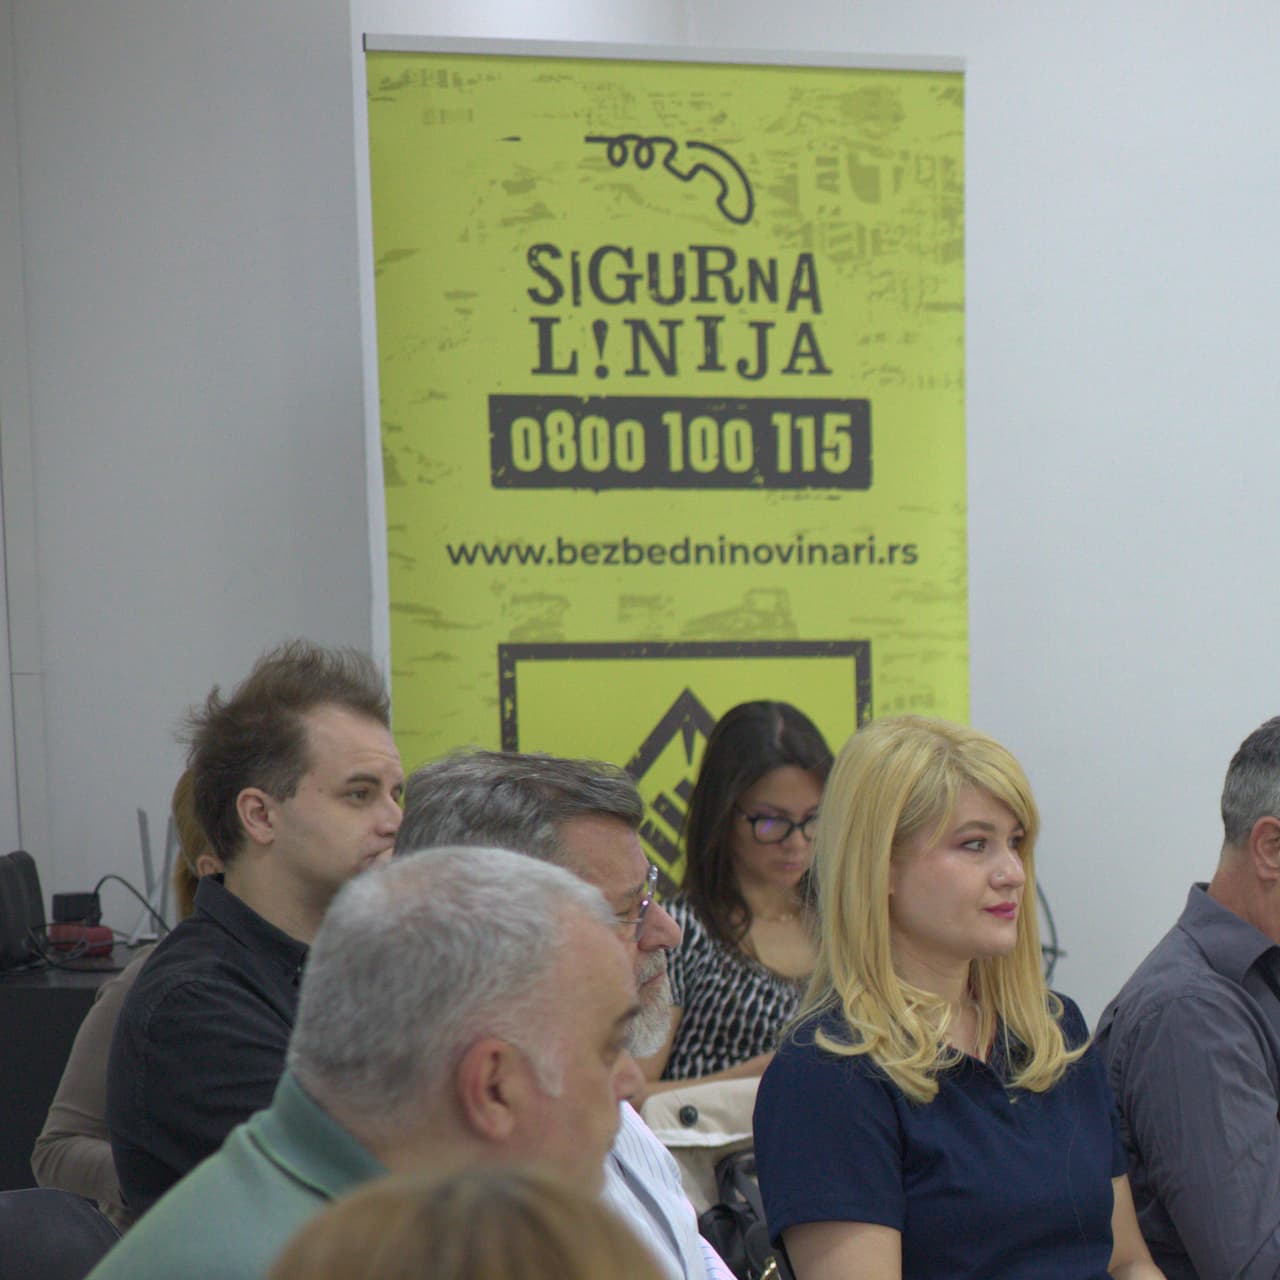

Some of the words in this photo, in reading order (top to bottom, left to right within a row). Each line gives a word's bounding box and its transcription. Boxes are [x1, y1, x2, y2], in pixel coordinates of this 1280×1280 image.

[511, 409, 645, 473] 0800
[662, 411, 754, 473] 100
[772, 412, 852, 473] 115
[446, 537, 919, 566] www.bezbedninovinari.rs
